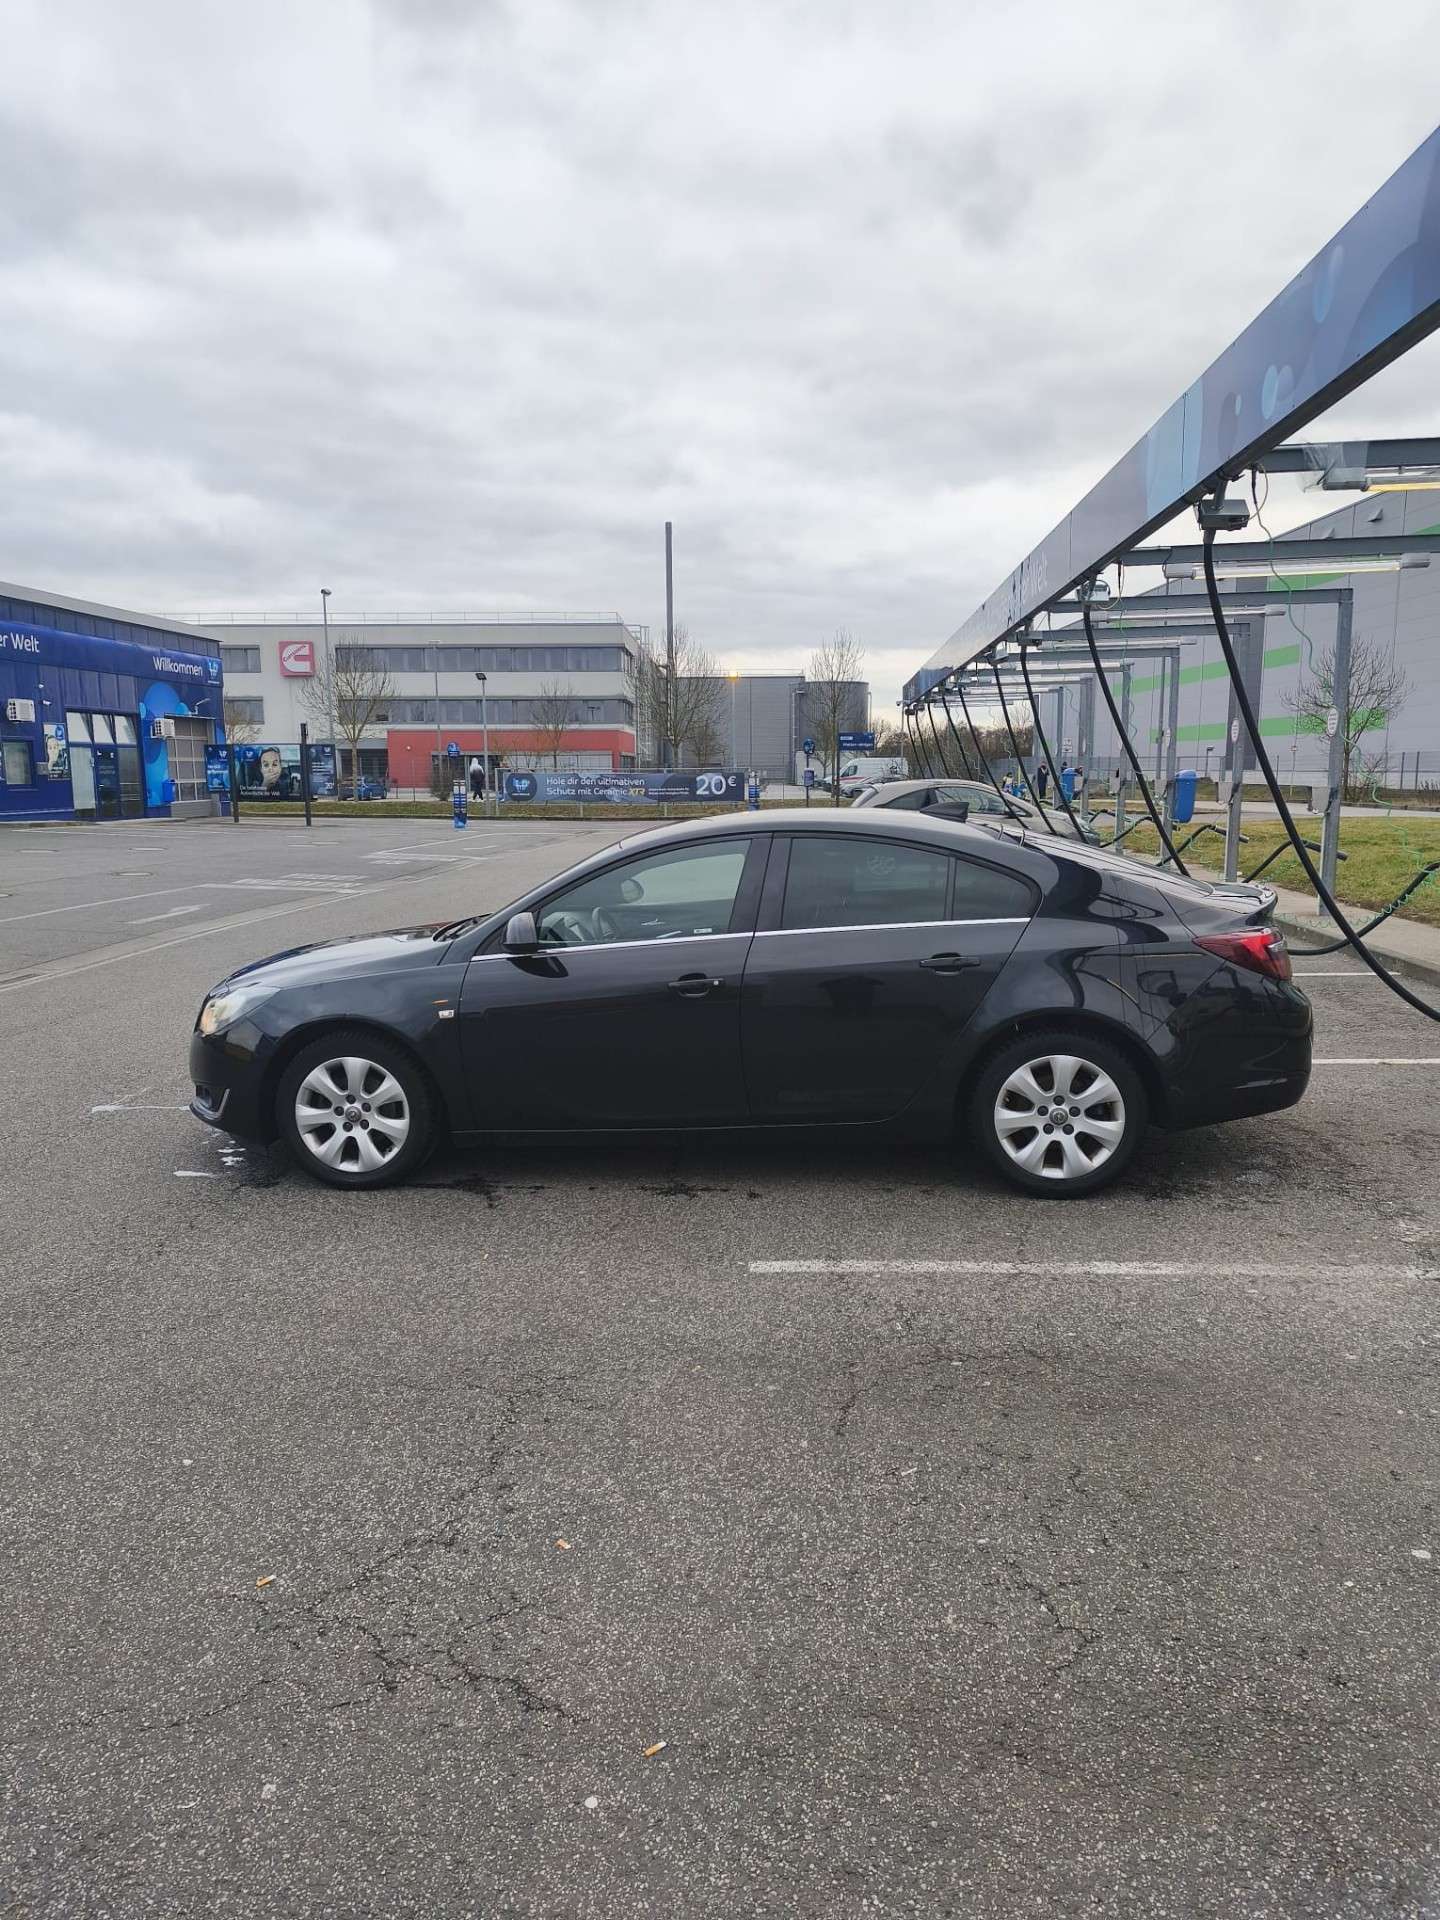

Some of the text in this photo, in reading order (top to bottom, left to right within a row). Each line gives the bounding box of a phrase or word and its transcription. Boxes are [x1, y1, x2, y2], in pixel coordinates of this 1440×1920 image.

[10, 631, 40, 653] Welt
[152, 655, 203, 677] Willkommen
[546, 776, 645, 786] Hole dir den ultimativen
[546, 787, 576, 796] Schutz
[578, 787, 591, 796] mit
[593, 787, 627, 796] Ceramic
